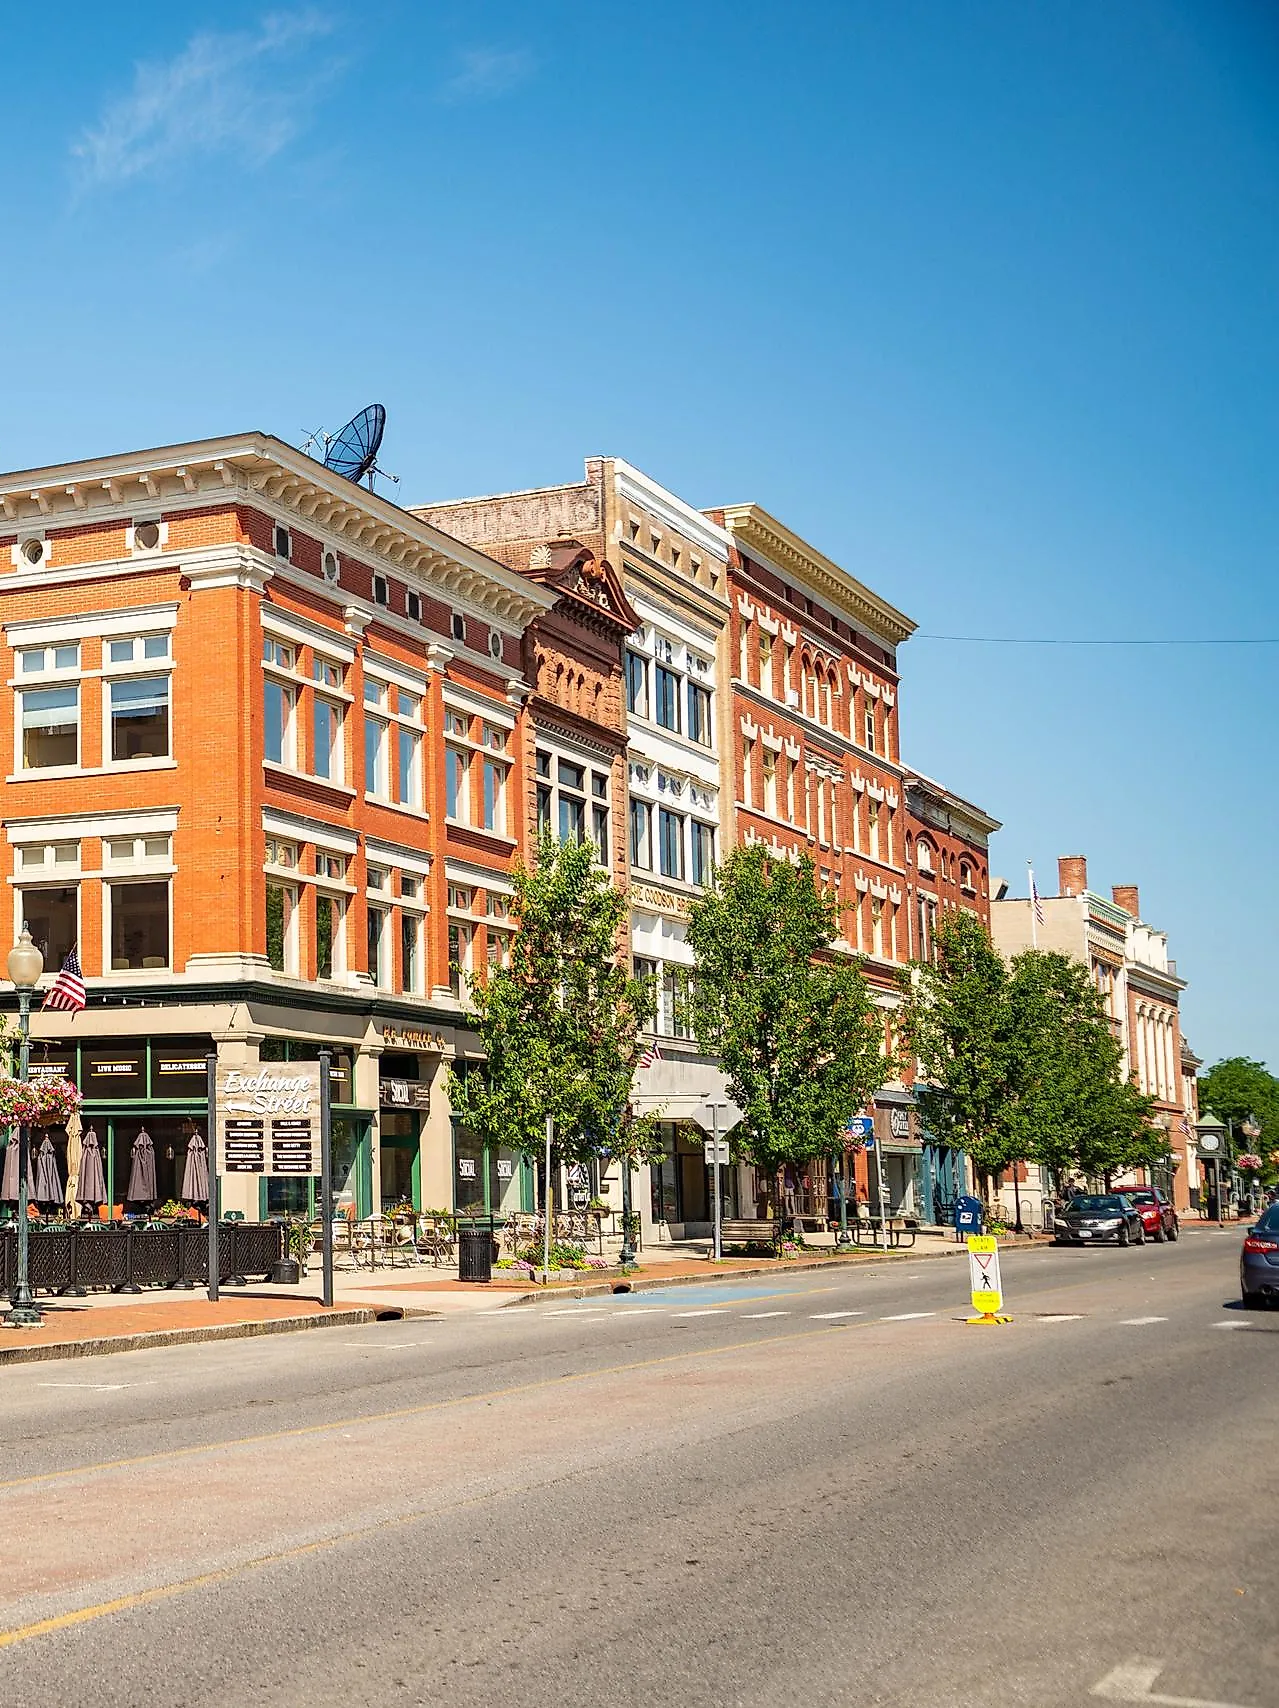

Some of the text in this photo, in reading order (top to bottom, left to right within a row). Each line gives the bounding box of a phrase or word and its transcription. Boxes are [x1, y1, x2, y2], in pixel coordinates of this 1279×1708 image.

[28, 1065, 67, 1074] ESTAURANT
[97, 1064, 132, 1073] LIVE MUSIC
[160, 1062, 207, 1071] DELICATESSEN
[223, 1068, 312, 1096] Exchange
[252, 1094, 313, 1115] Street
